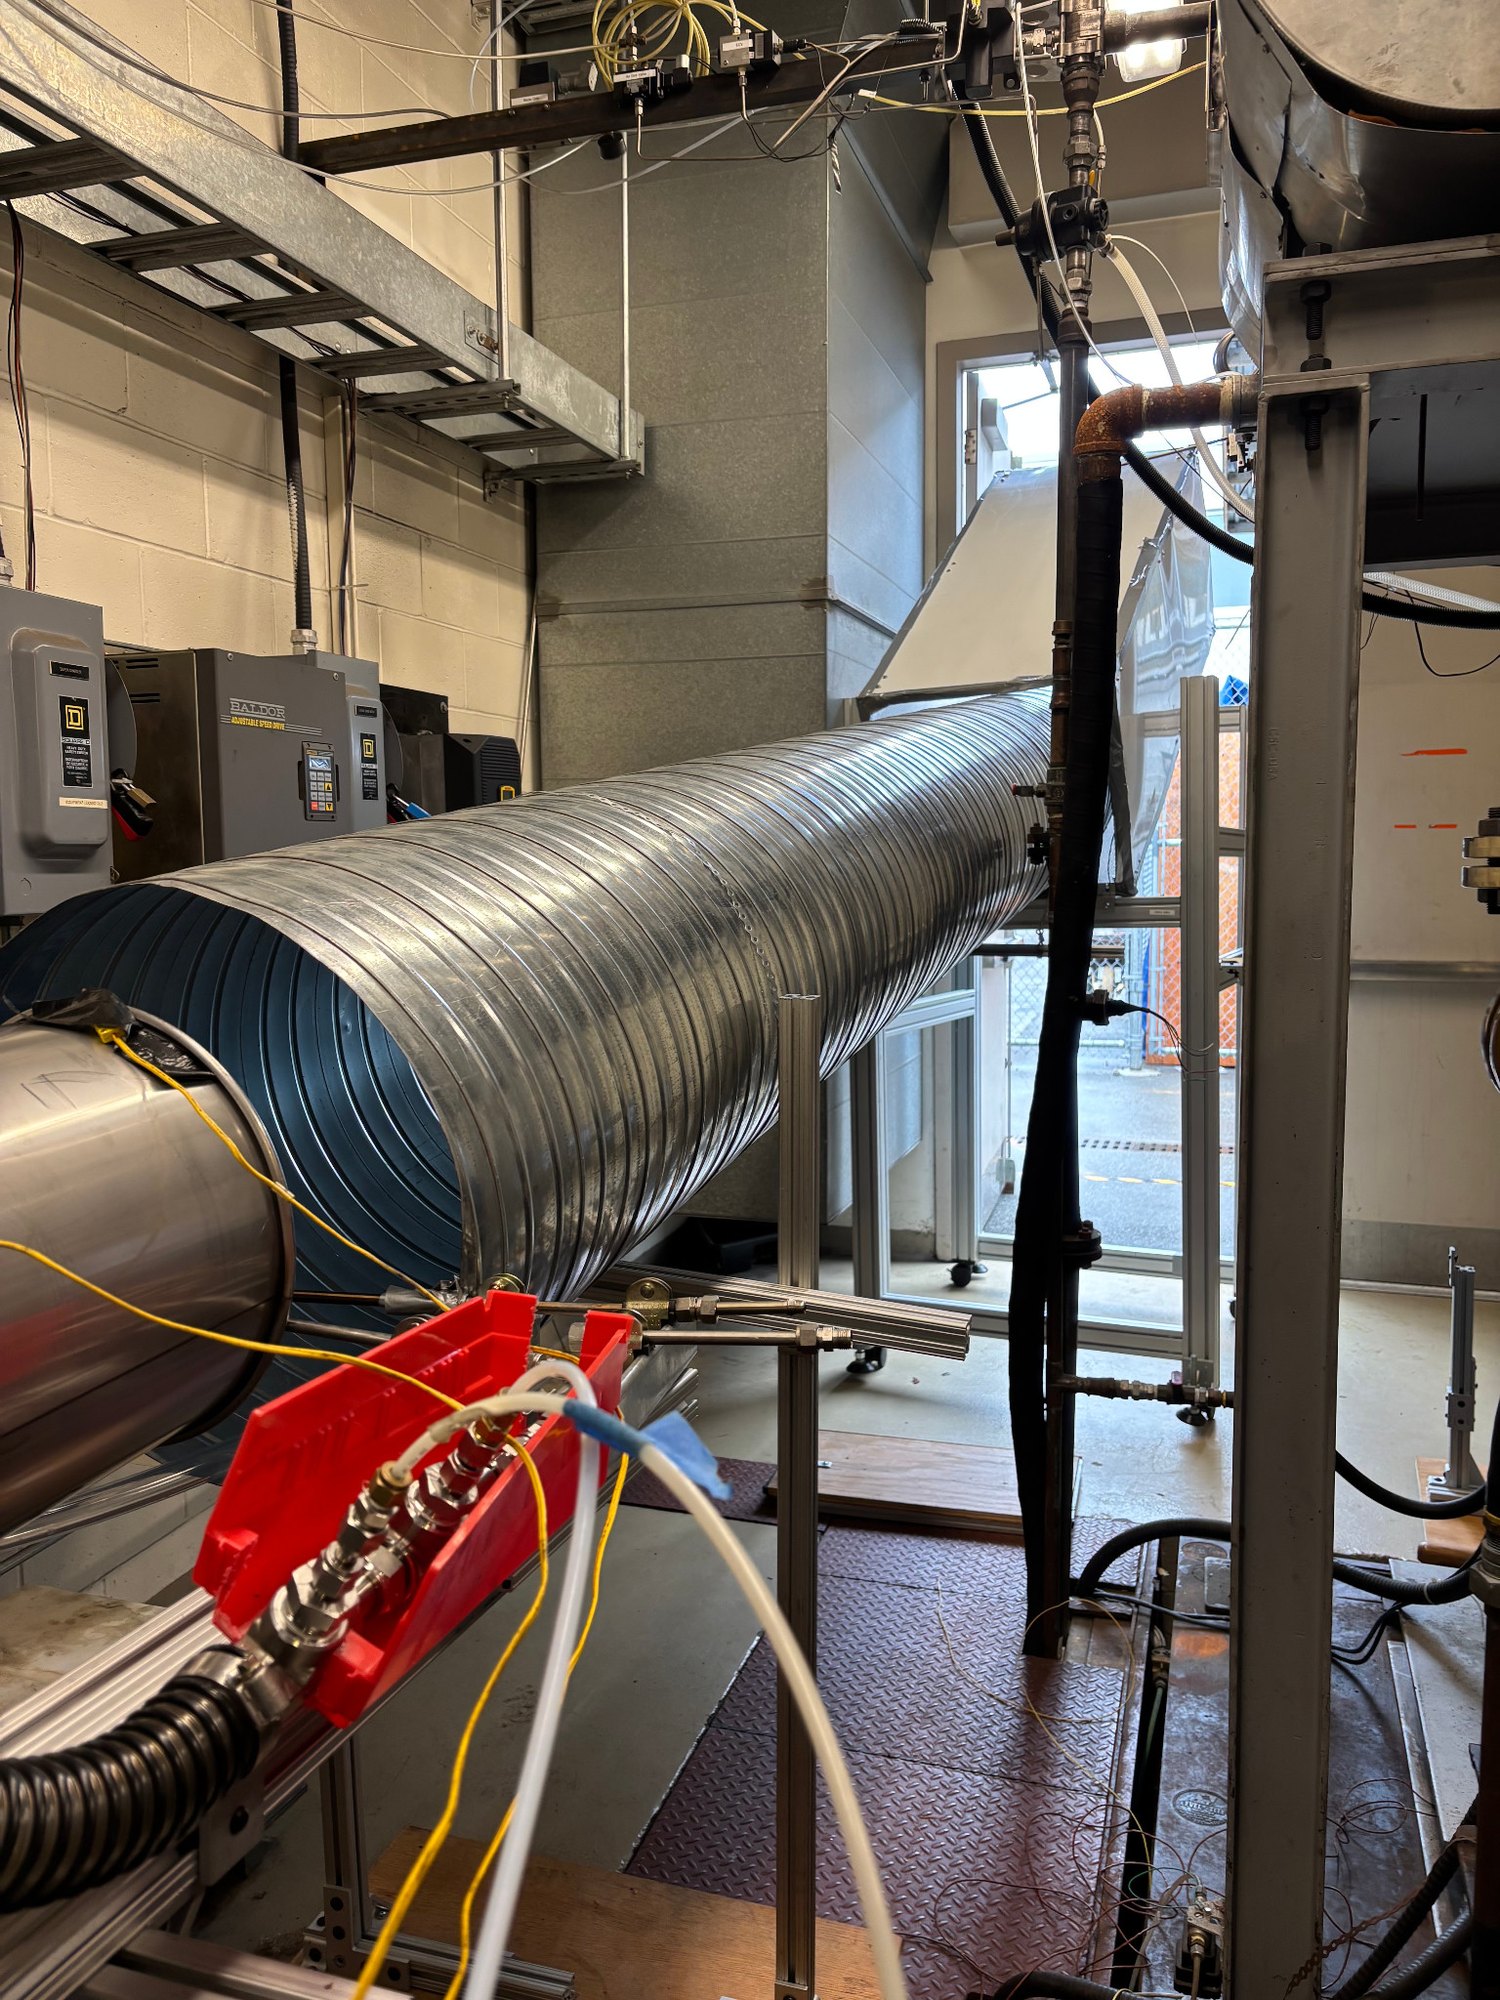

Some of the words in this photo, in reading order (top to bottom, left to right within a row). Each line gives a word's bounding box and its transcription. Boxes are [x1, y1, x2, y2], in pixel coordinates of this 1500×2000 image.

[230, 701, 285, 719] BALDOR
[231, 716, 258, 727] ADJUSTABLE
[259, 719, 272, 729] SPEED
[272, 721, 285, 730] DRIVE
